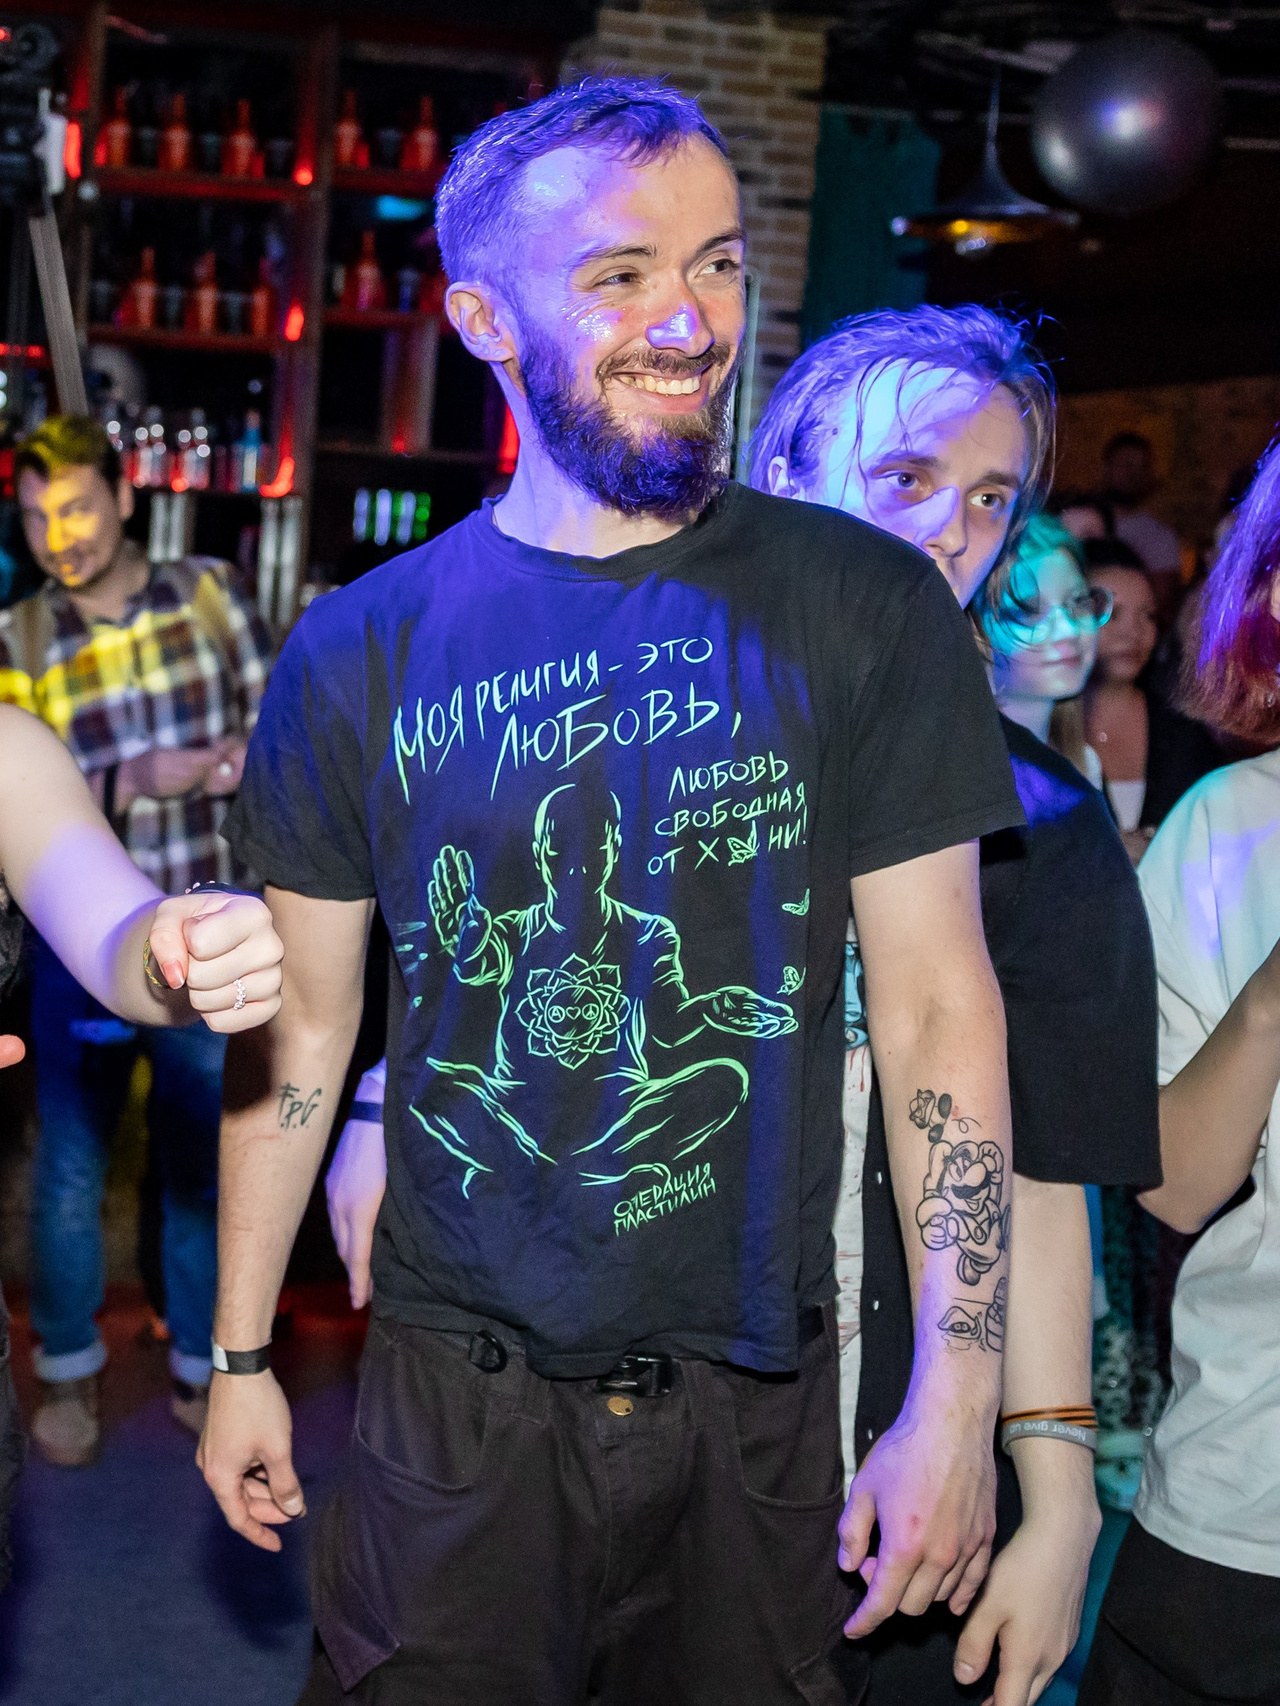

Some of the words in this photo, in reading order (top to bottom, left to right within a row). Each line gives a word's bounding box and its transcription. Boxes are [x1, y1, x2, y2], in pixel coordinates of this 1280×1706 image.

[393, 696, 465, 806] МОЯ
[475, 649, 600, 740] РЕЛИГИЯ
[637, 636, 714, 675] ЭТО
[668, 750, 789, 803] ЛЮБОВЬ
[654, 781, 806, 838] СВОБОДНАЯ
[647, 846, 685, 875] ОТ
[613, 1162, 711, 1217] ОПЕРАЦИЯ
[613, 1177, 716, 1237] ПЛАСТИЛИН
[1024, 1420, 1049, 1434] give
[1051, 1424, 1087, 1442] Never
